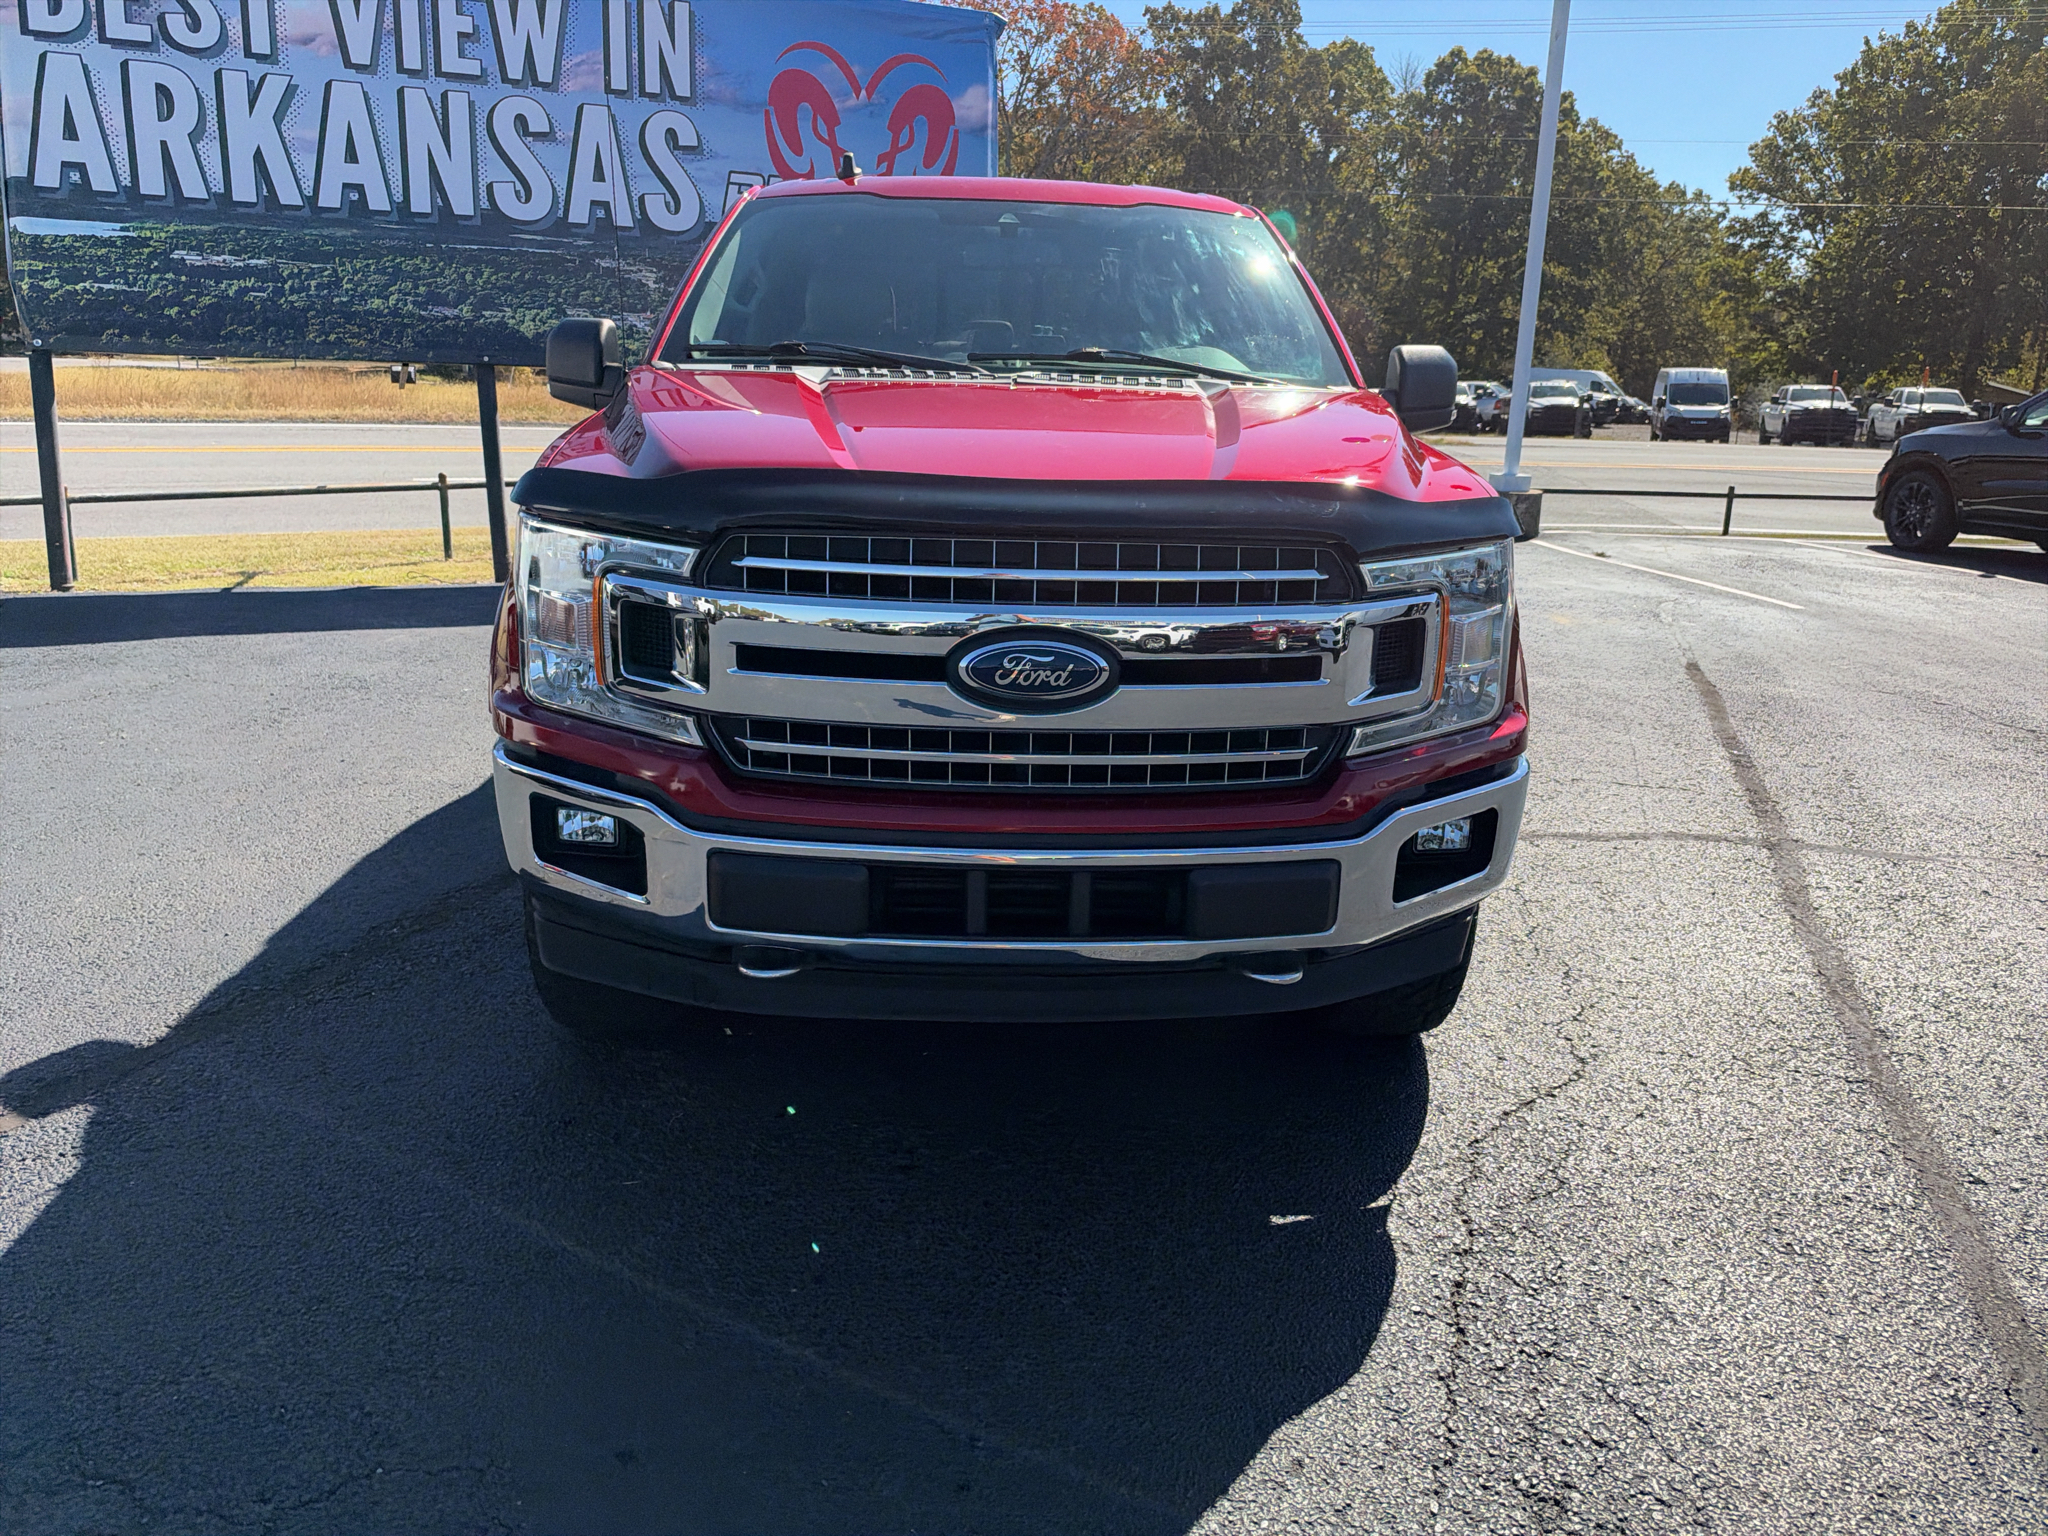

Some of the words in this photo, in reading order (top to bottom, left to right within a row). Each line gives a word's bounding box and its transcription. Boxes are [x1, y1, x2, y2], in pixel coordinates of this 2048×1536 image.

[329, 0, 563, 86] VIEW
[603, 0, 692, 98] IN
[33, 51, 699, 232] ARKANSAS
[994, 653, 1074, 686] Ford
